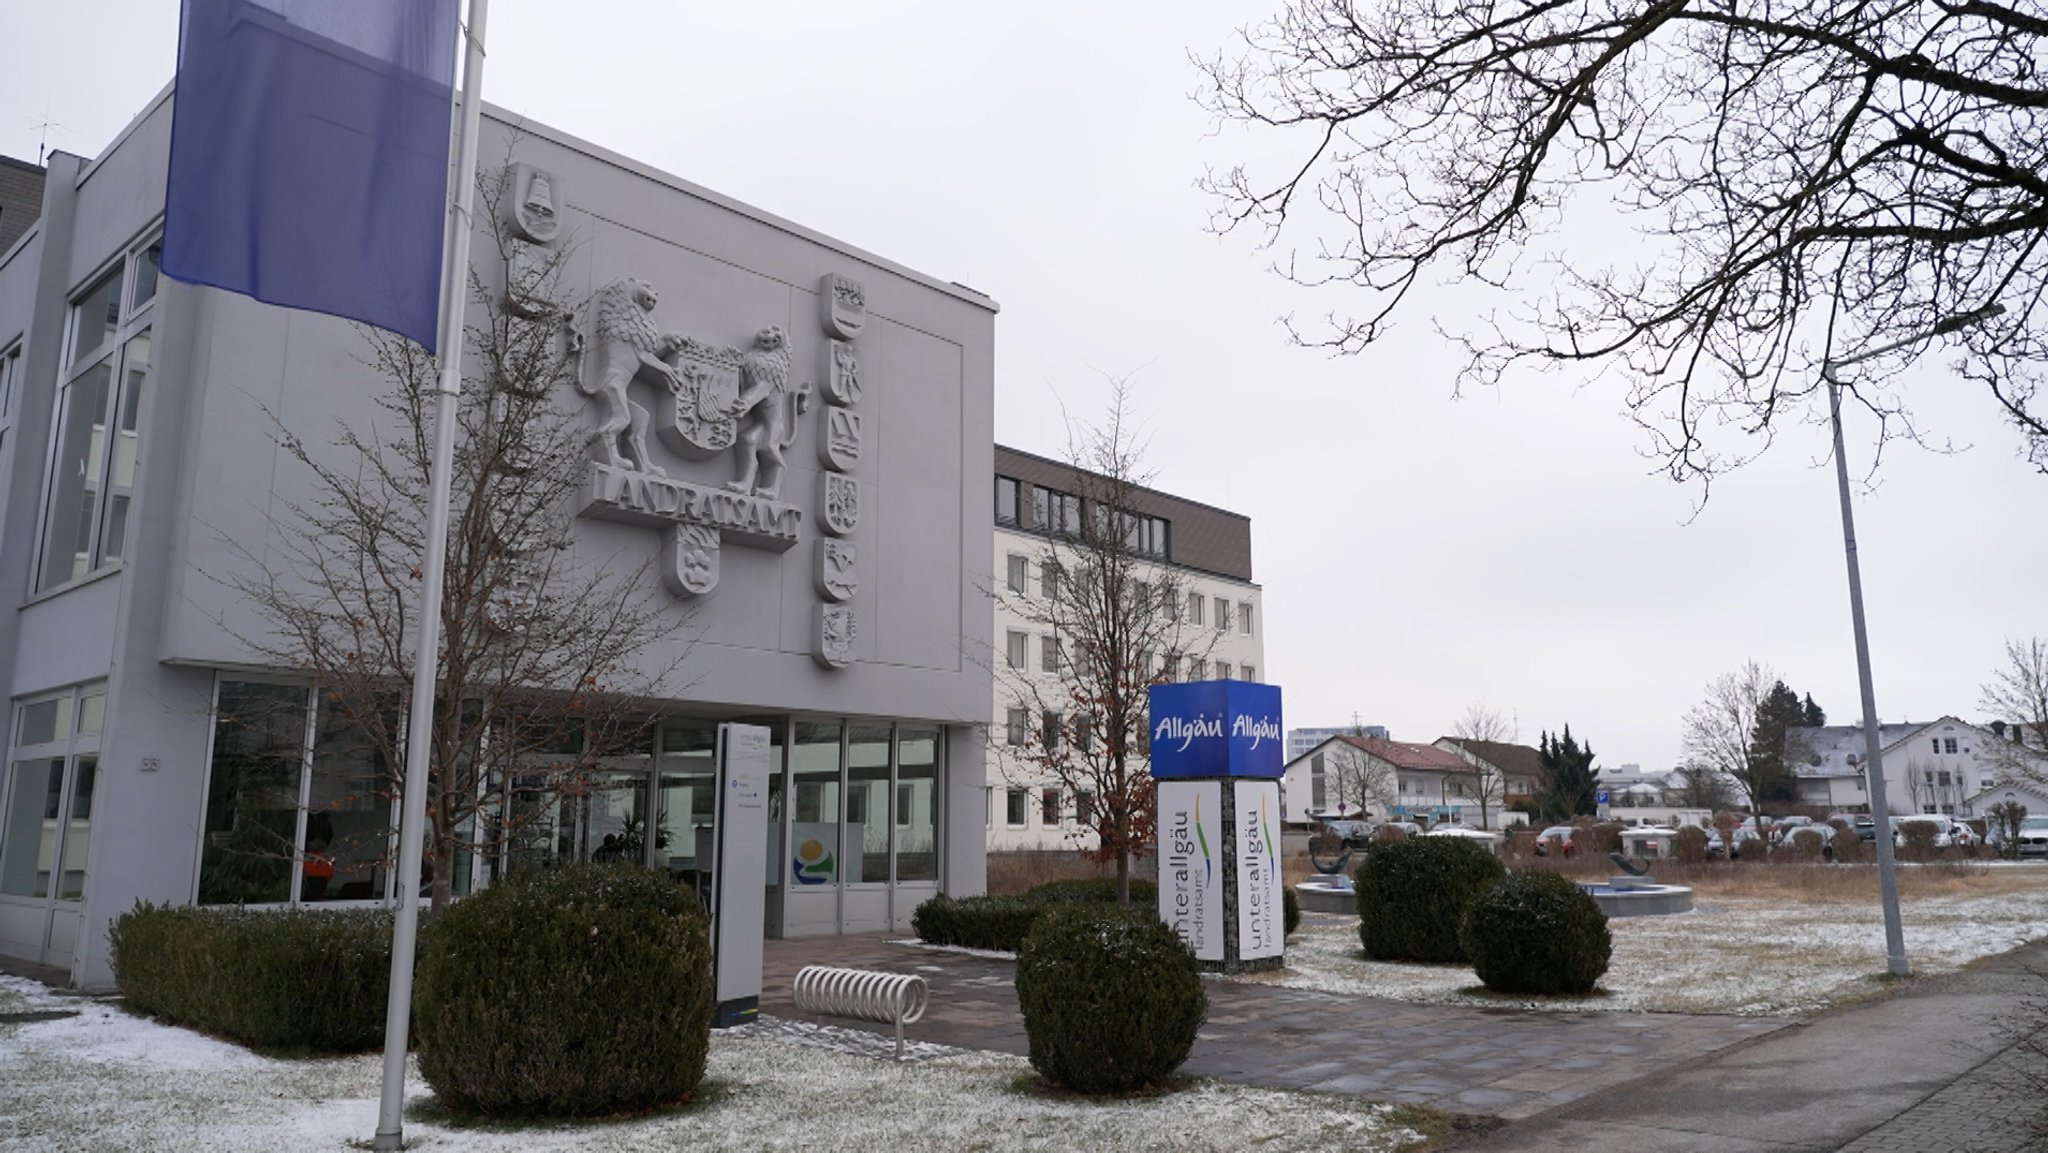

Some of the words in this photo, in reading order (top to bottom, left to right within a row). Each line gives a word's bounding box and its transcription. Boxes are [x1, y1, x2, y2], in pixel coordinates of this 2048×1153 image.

[592, 468, 802, 538] LANDRATSAMT
[1154, 713, 1223, 752] Allgäu
[1232, 714, 1280, 750] Allgäu
[1193, 868, 1204, 950] landratsamt
[1244, 810, 1263, 950] unterallgäu
[1263, 868, 1272, 948] landratsamt
